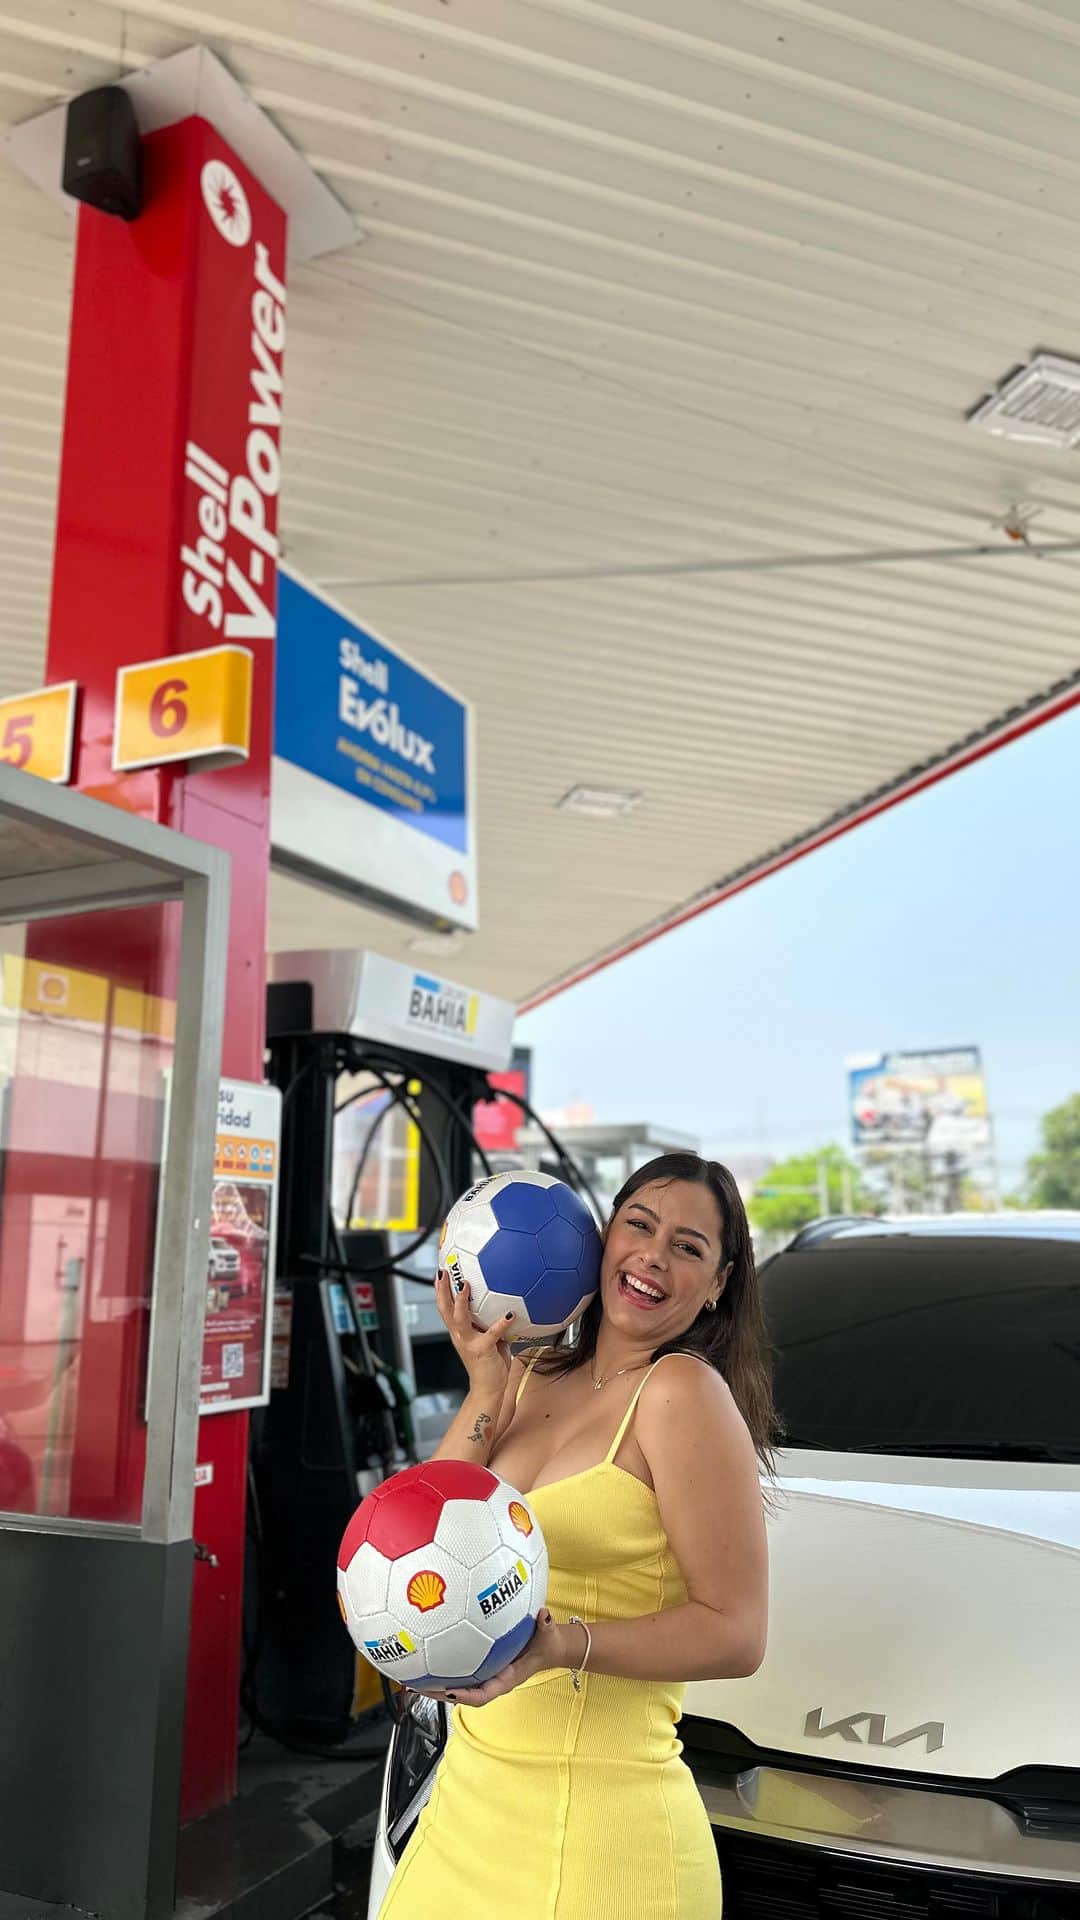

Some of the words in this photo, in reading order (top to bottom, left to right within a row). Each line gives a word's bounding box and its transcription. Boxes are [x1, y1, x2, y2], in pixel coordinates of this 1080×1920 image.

[224, 241, 287, 638] V-Power
[181, 440, 229, 629] Shell
[339, 637, 388, 693] Shell
[148, 678, 188, 738] 6
[2, 714, 35, 767] 5
[409, 989, 467, 1032] BAHIA
[480, 1574, 523, 1615] BAHIA
[497, 1566, 517, 1587] GRUPO
[367, 1641, 409, 1661] BAHIA
[803, 1706, 945, 1754] KIA
